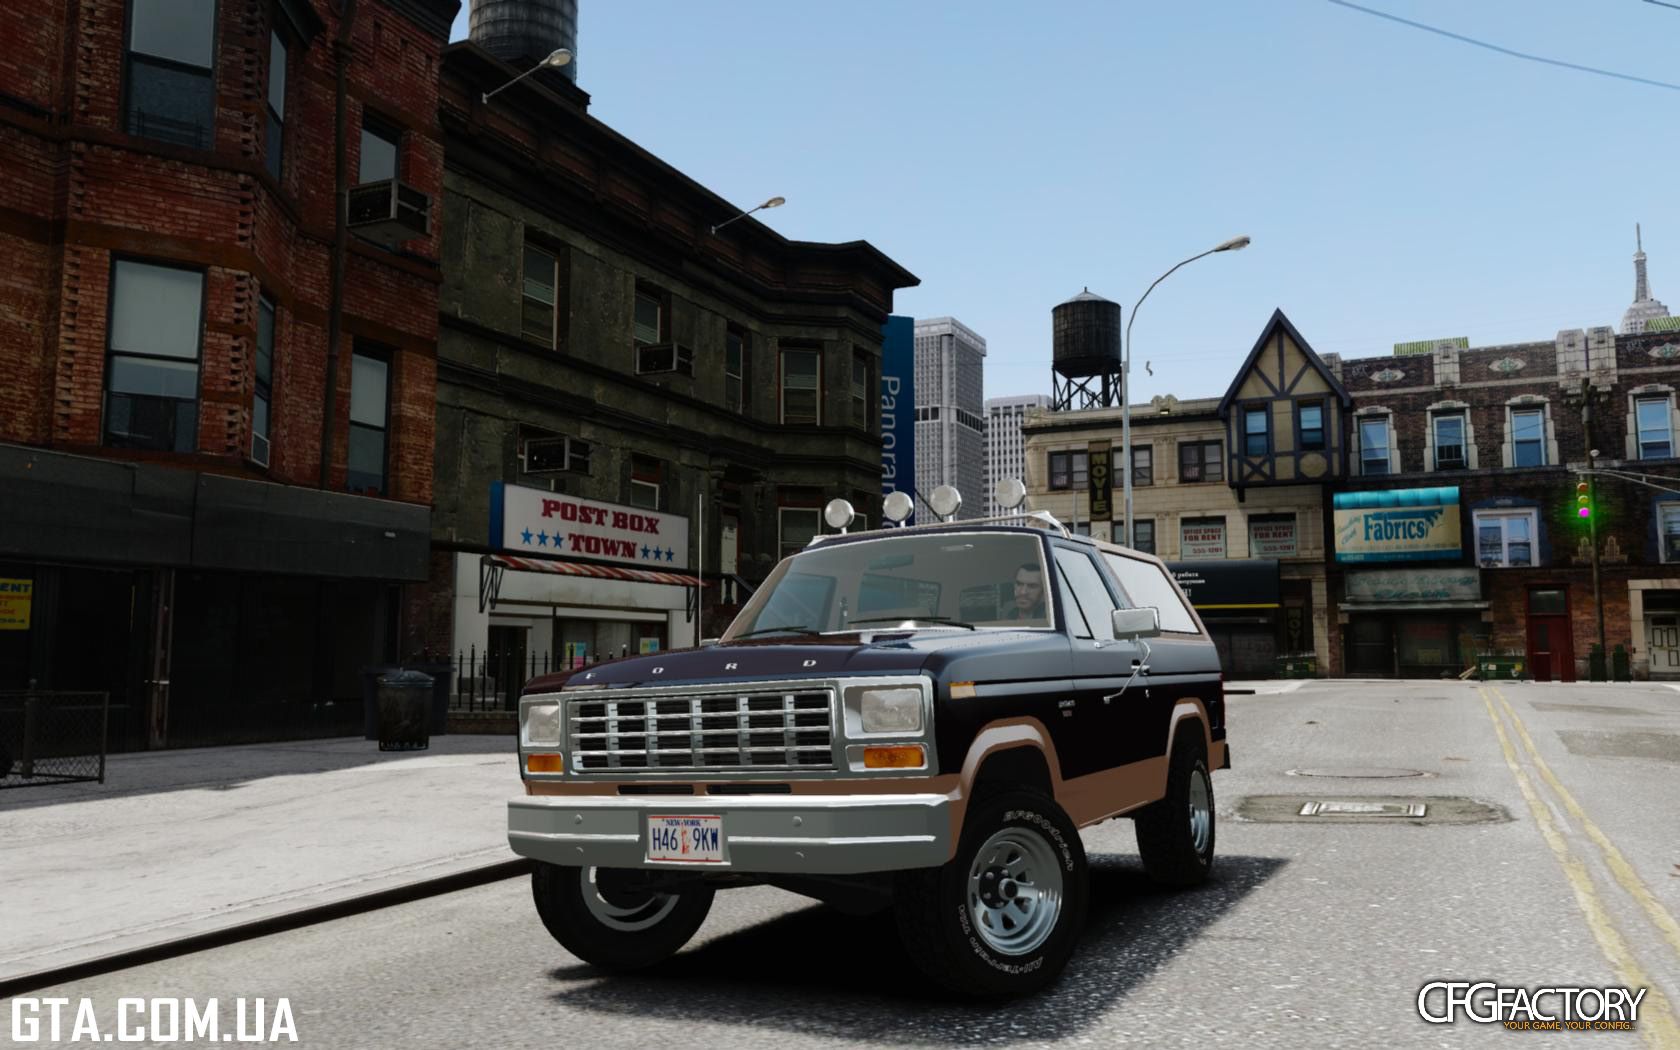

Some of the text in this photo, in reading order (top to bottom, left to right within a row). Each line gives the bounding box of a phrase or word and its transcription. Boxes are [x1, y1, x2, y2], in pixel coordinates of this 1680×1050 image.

[881, 376, 901, 526] Panora
[1091, 452, 1107, 512] MOVIE
[541, 498, 660, 534] POST BOX
[1363, 513, 1426, 541] Fabrics
[568, 532, 637, 559] TOWN
[1201, 533, 1221, 541] RENT
[1254, 530, 1293, 539] FOR RENT
[585, 659, 817, 680] FORD
[652, 828, 719, 851] H46 9KW
